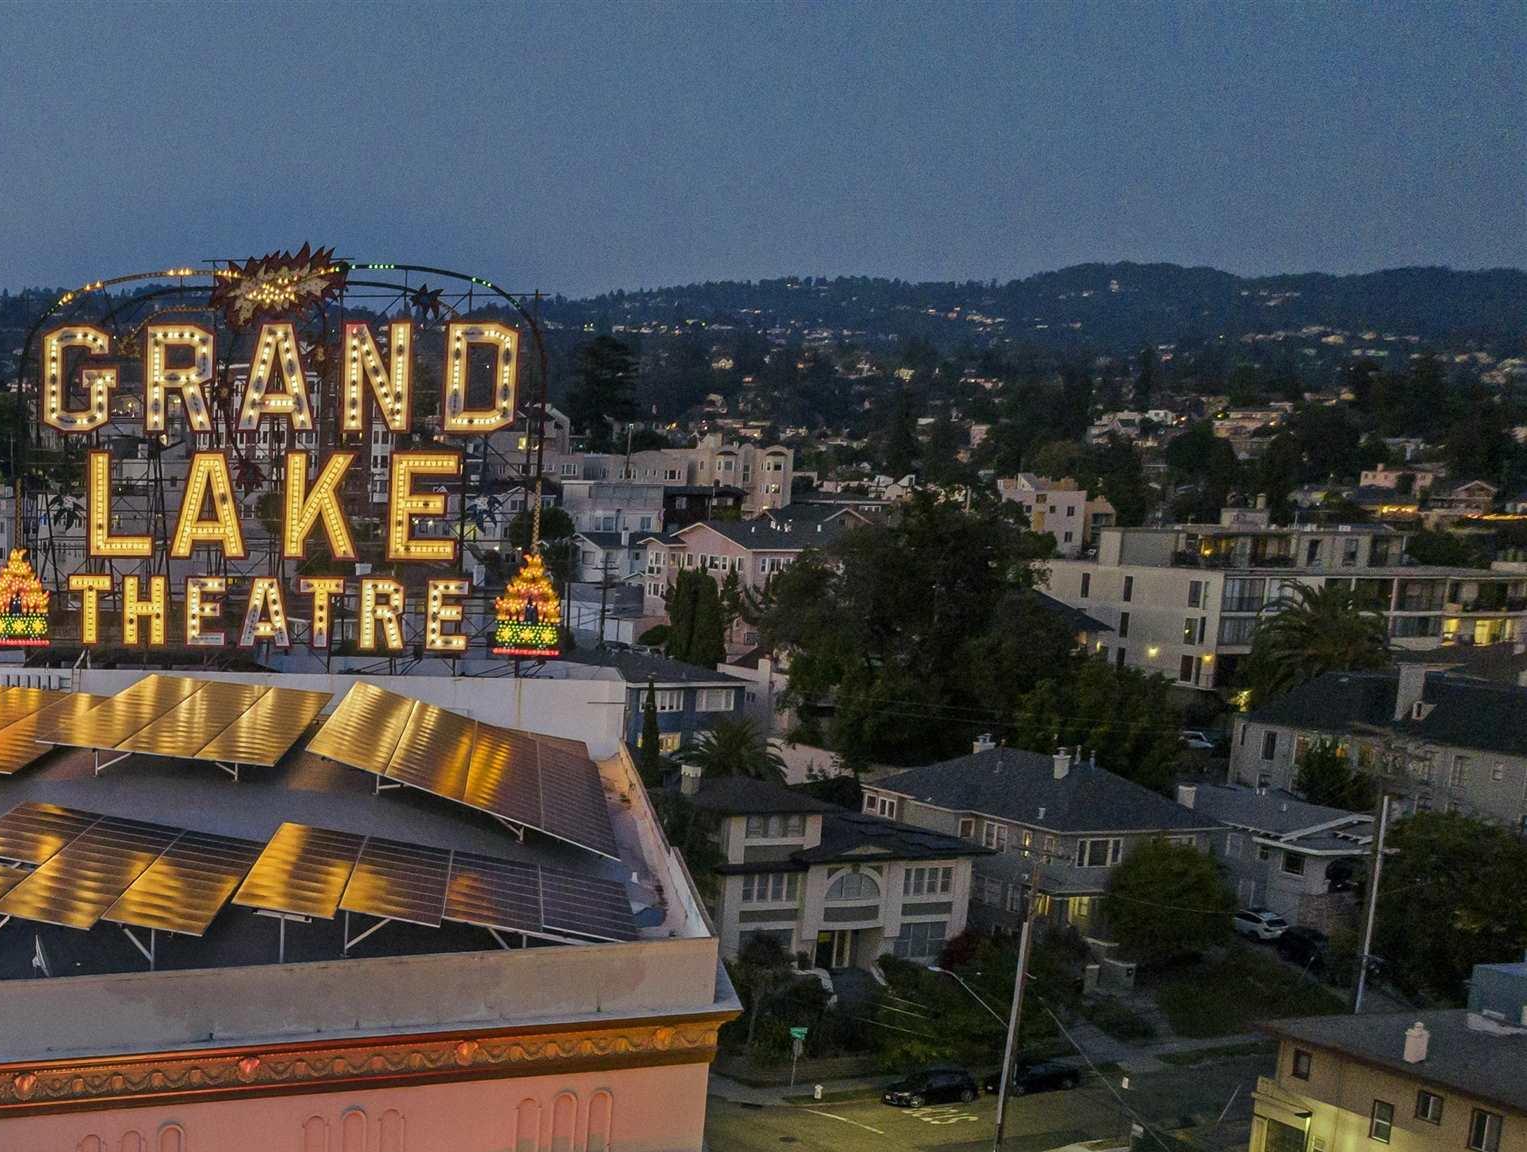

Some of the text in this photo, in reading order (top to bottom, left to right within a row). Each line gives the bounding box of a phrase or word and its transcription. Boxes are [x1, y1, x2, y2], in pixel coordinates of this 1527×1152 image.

[42, 320, 521, 434] GRAND
[87, 450, 462, 560] LAKE
[68, 574, 470, 651] THEATRE
